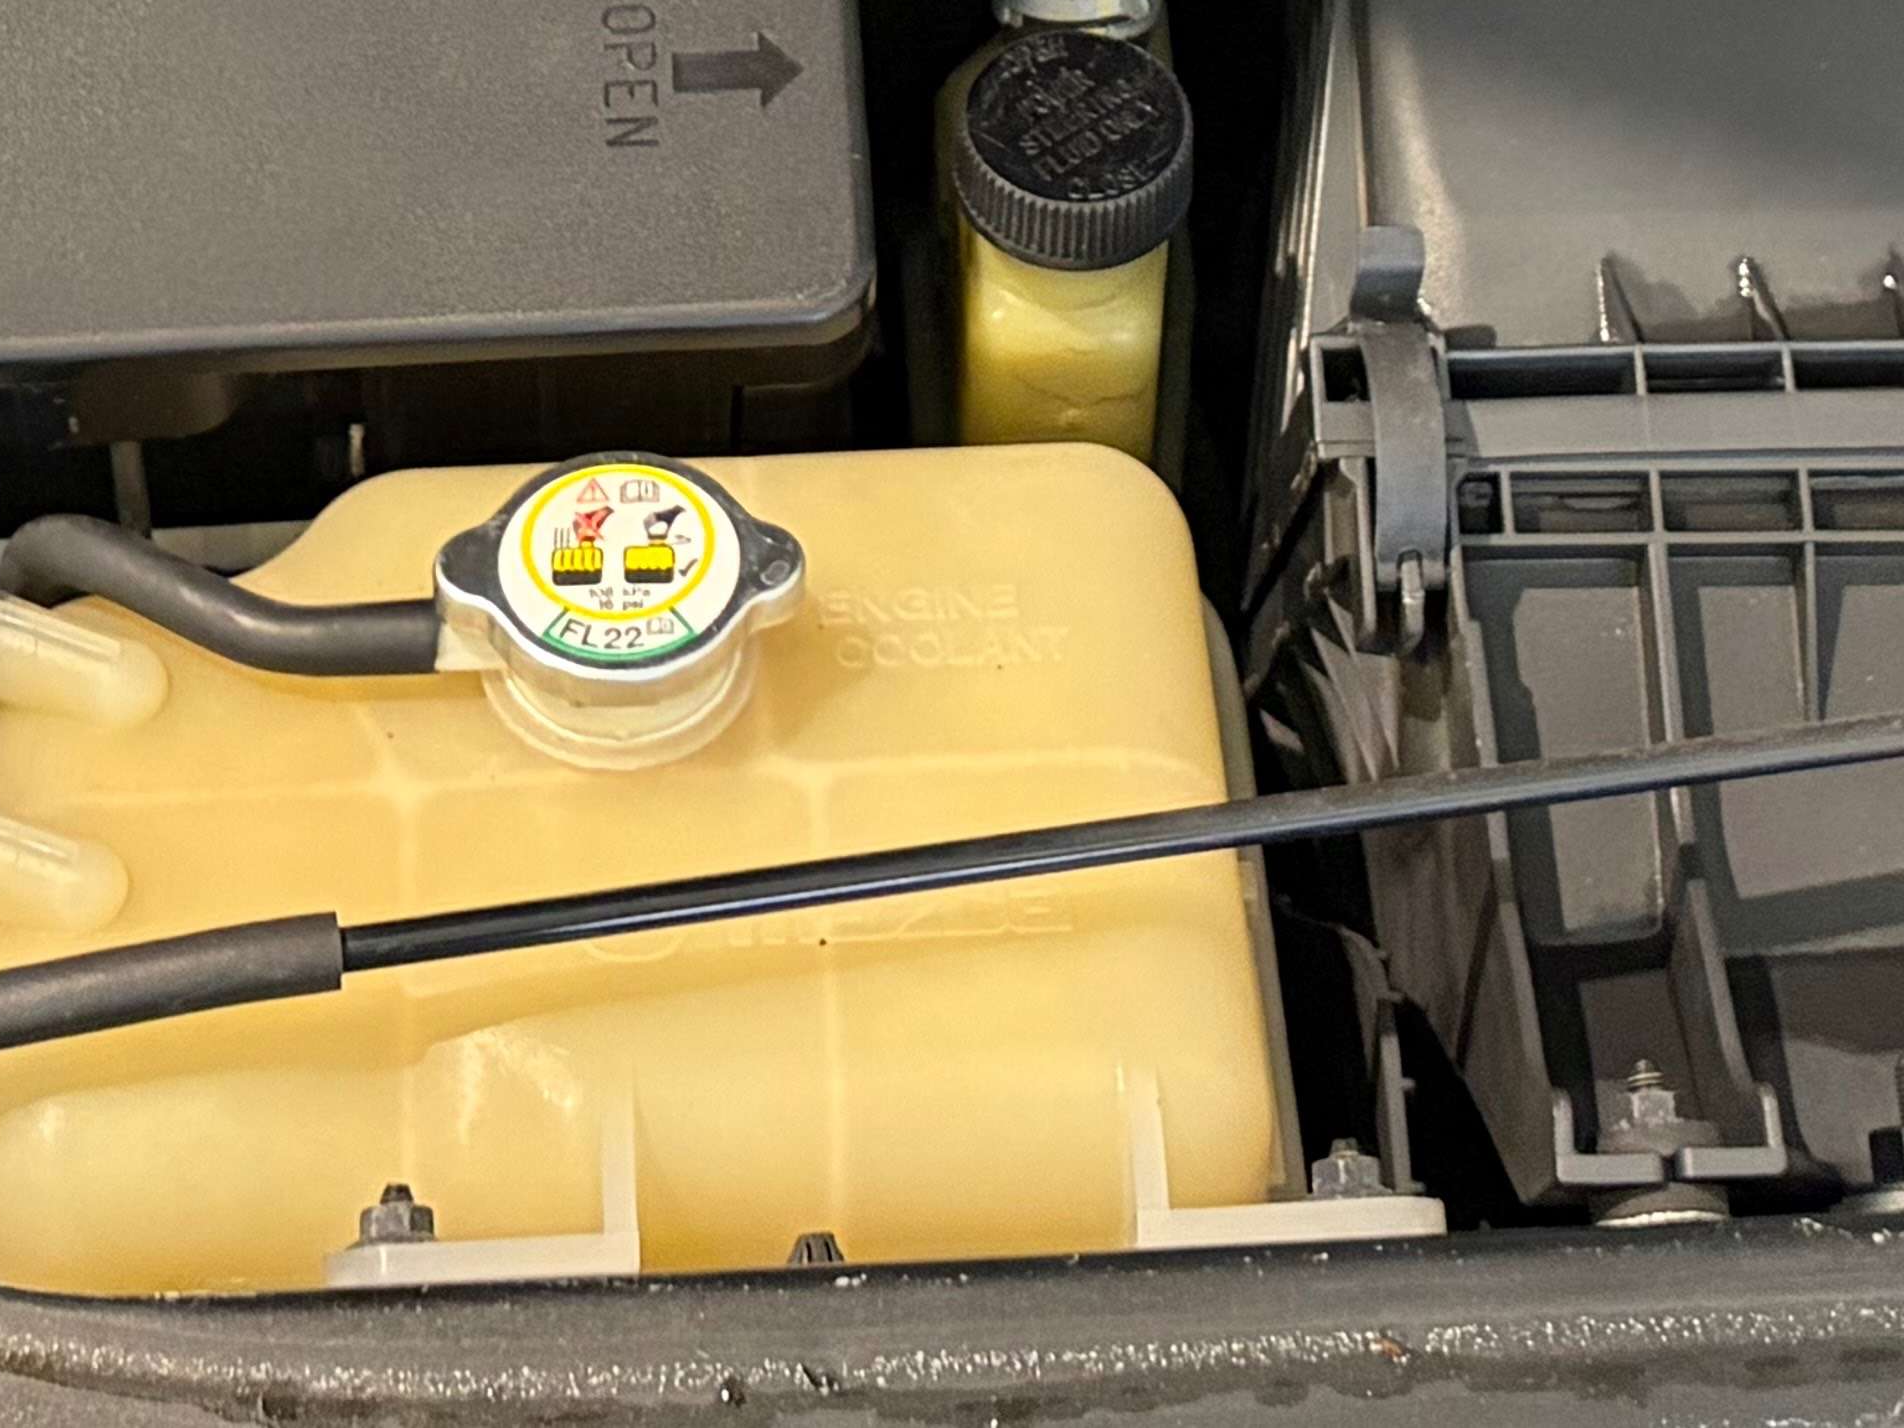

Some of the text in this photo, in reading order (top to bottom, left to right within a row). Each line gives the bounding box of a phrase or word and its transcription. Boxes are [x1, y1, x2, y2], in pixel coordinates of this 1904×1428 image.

[601, 3, 660, 148] OPEN
[817, 583, 1020, 625] ENGINE
[835, 625, 1070, 668] COOLANT
